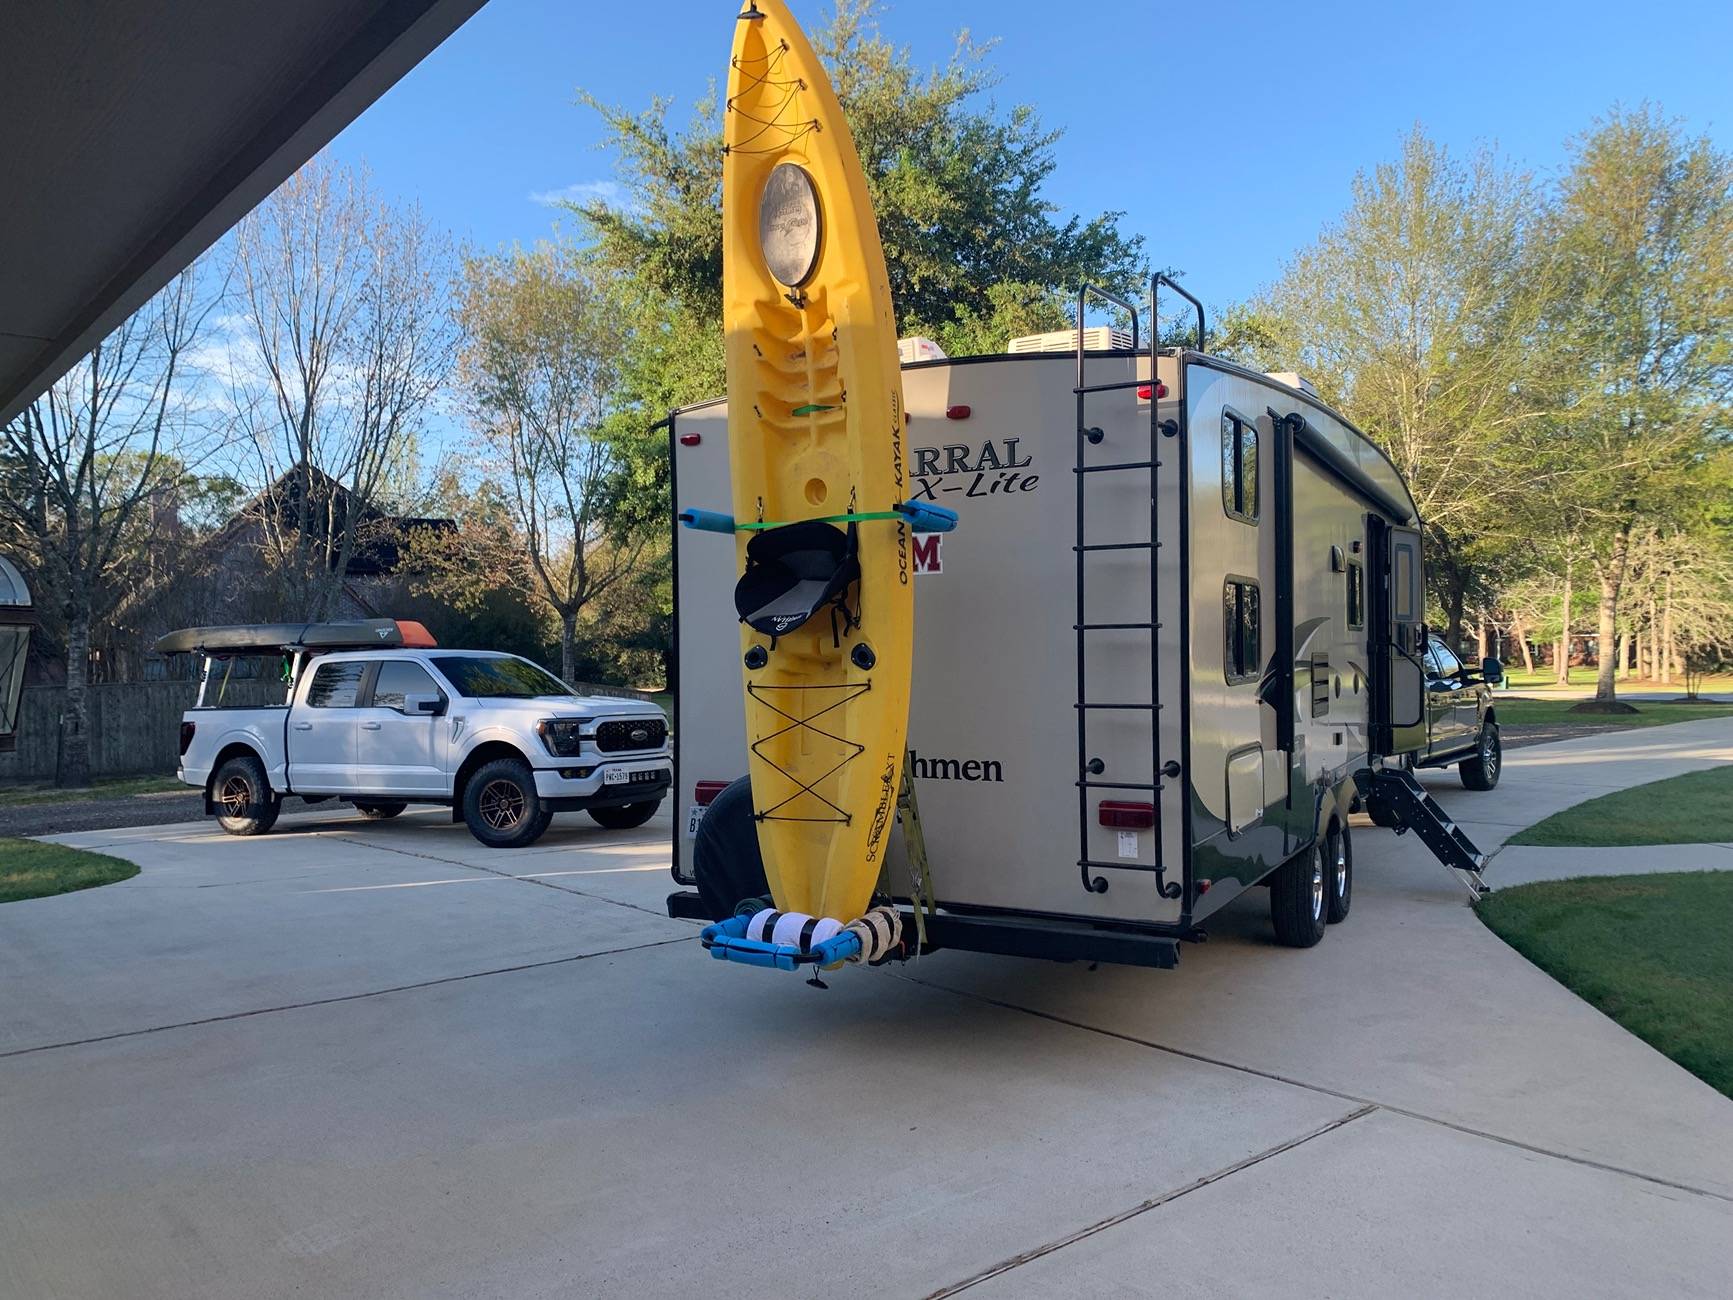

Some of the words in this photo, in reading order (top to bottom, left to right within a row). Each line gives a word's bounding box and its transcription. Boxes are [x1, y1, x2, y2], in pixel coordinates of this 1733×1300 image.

[891, 425, 902, 488] KAYAK
[909, 437, 1033, 477] RRAL
[911, 472, 1040, 501] X-Lite
[897, 520, 908, 585] OCEAN
[912, 535, 941, 572] M
[909, 750, 1004, 782] hmen
